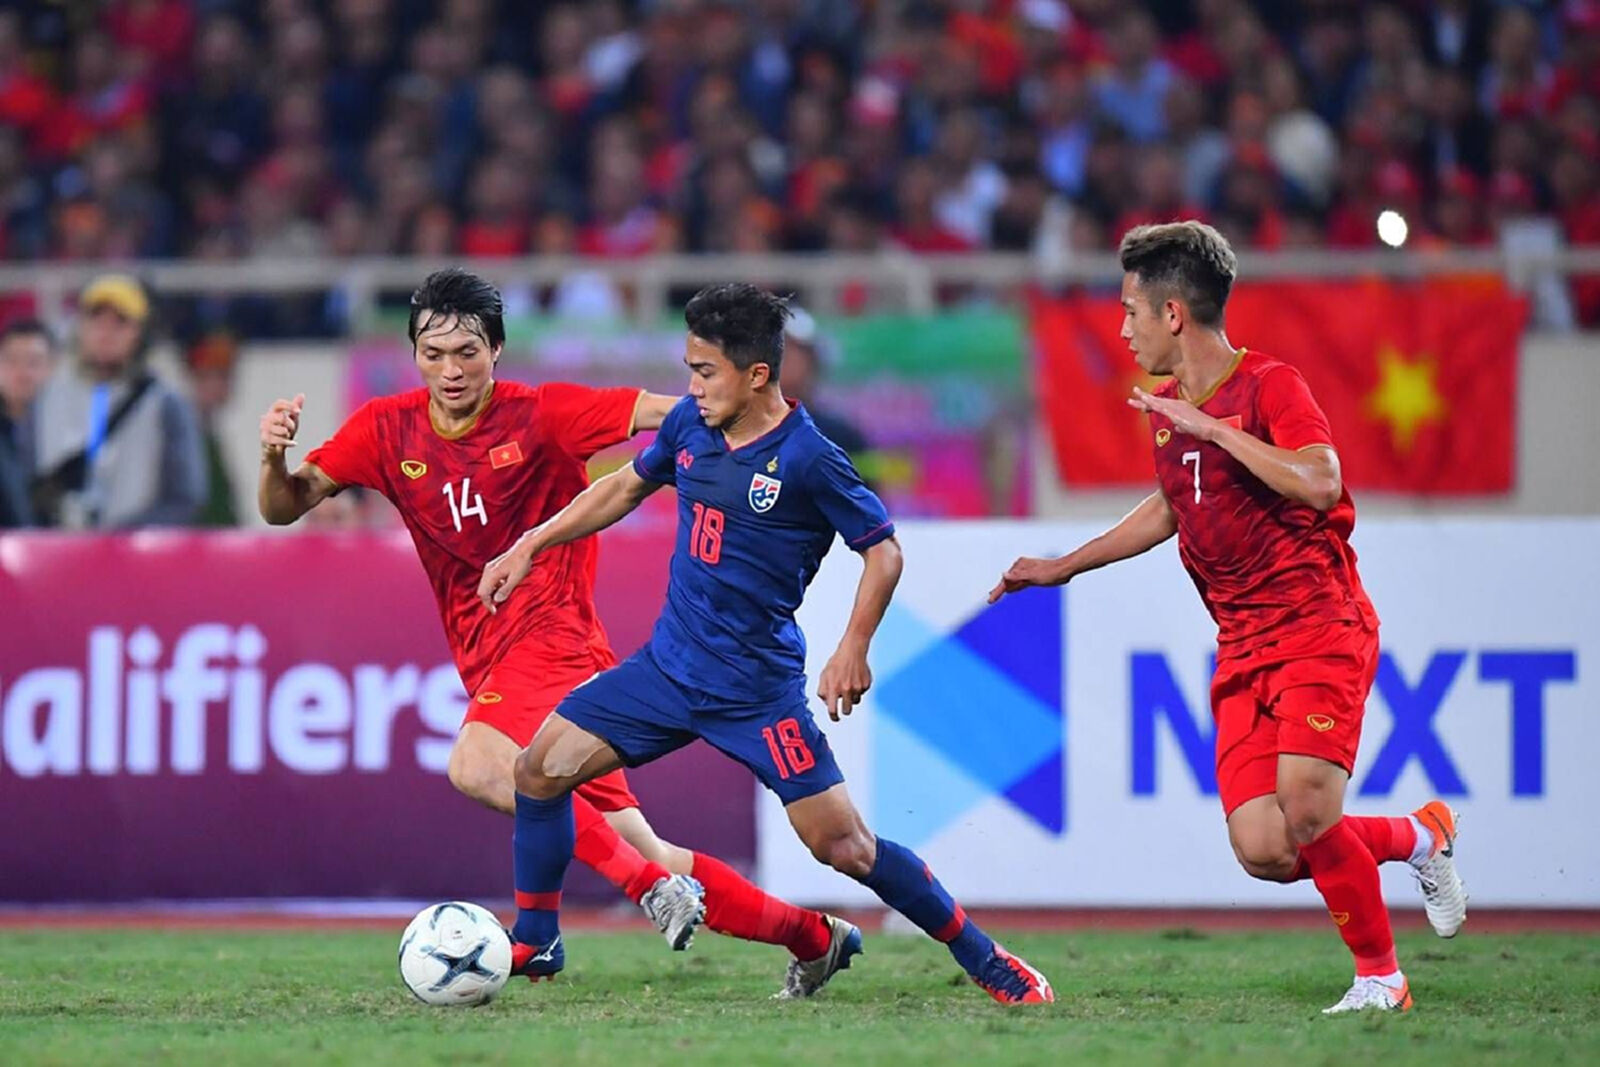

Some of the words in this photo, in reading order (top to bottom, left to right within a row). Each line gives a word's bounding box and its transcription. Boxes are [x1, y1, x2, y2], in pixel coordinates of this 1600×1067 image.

[442, 477, 488, 533] 14
[1182, 451, 1201, 504] 7
[690, 503, 725, 565] 18
[762, 718, 815, 780] 18
[1129, 650, 1578, 797] NXT
